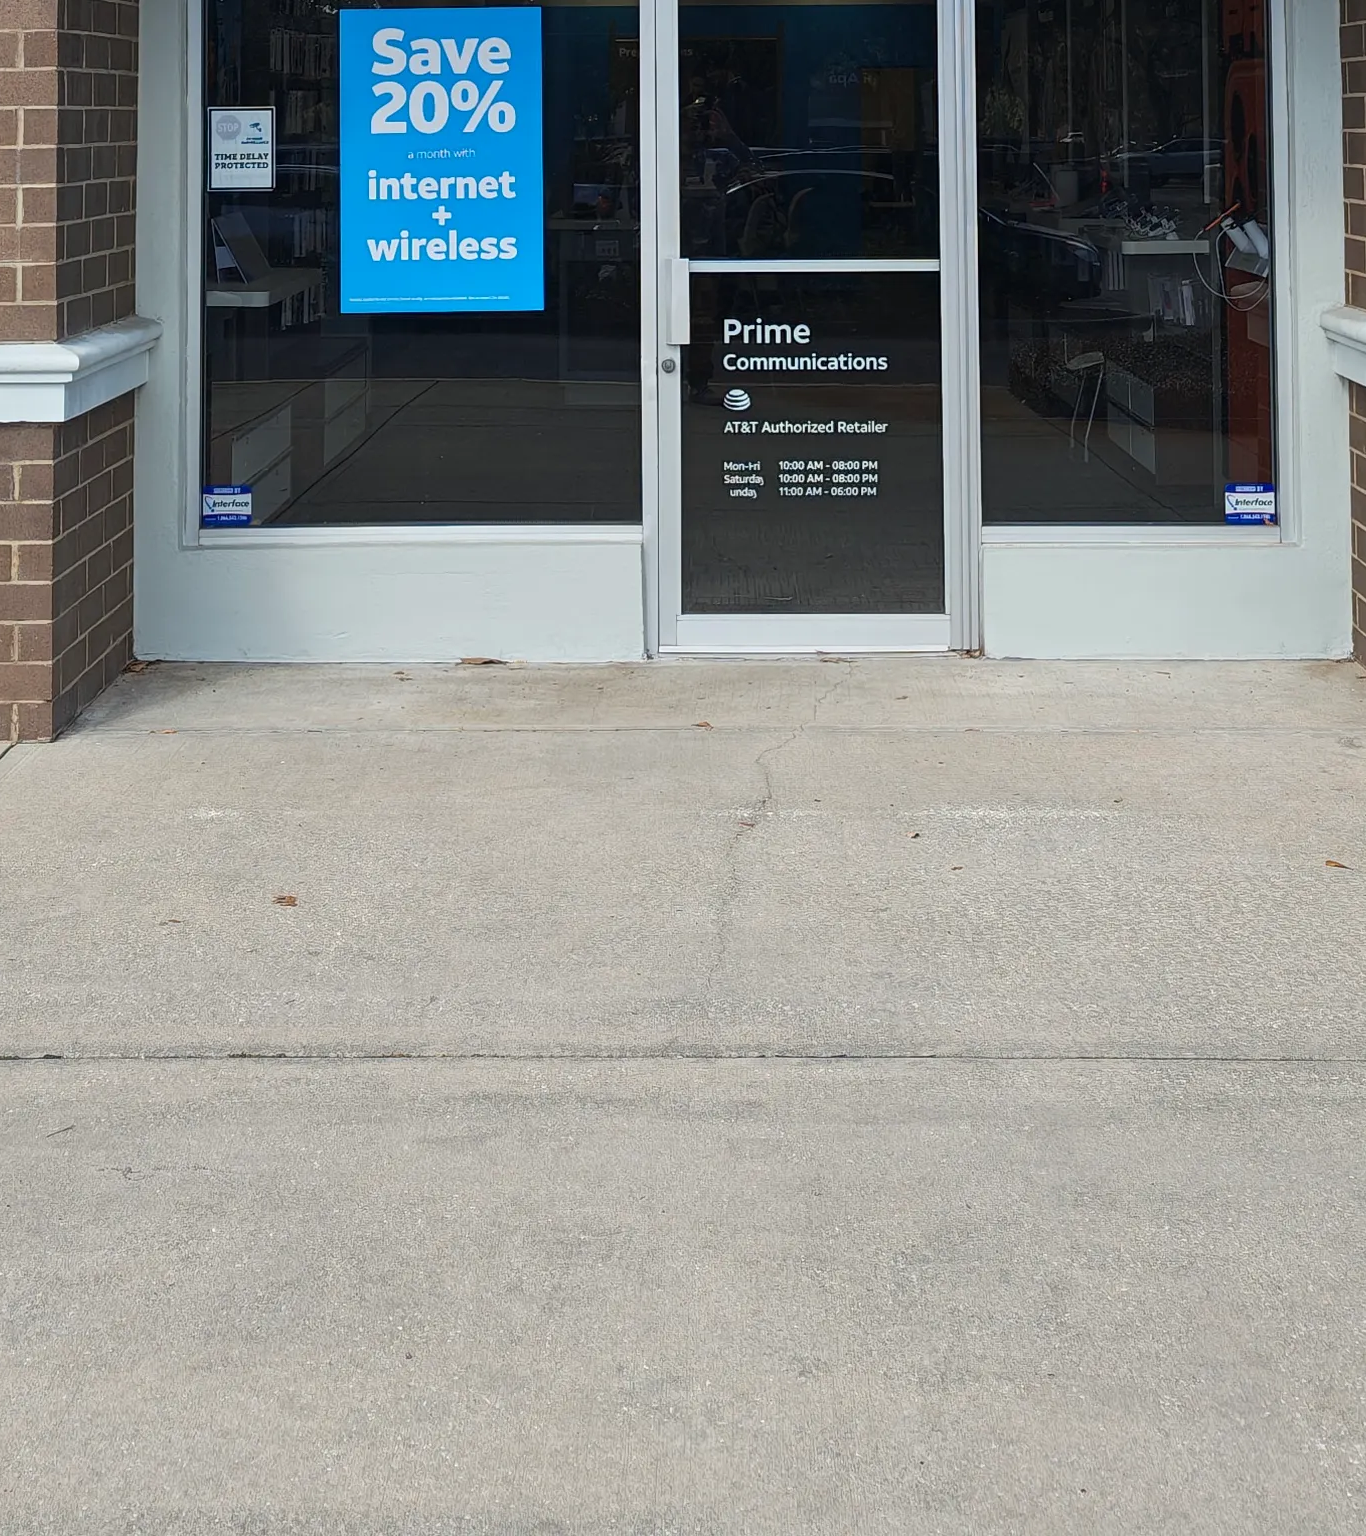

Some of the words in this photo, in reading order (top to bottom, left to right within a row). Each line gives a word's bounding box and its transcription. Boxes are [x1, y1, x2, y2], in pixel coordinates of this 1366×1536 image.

[370, 27, 512, 76] Save
[370, 80, 517, 135] 20%
[217, 123, 240, 133] STOP
[214, 153, 238, 161] TIME
[239, 152, 269, 161] DELAY
[407, 151, 414, 159] a
[416, 148, 451, 159] month
[453, 147, 476, 158] with
[214, 161, 269, 169] PROTECTED
[367, 169, 517, 200] internet
[366, 229, 518, 262] wireless
[722, 317, 811, 345] Prime
[722, 352, 889, 371] Communications
[723, 421, 758, 434] AT&T
[761, 420, 835, 434] Authorized
[837, 420, 889, 434] Retailer
[778, 460, 805, 470] 10:00
[806, 460, 824, 470] AM
[832, 460, 860, 470] 08:00
[861, 460, 878, 470] PM
[778, 473, 805, 483] 10:00
[806, 473, 824, 483] AM
[832, 473, 860, 483] 08:00
[861, 473, 878, 483] PM
[778, 486, 804, 496] 11:00
[805, 486, 823, 496] AM
[830, 486, 859, 496] 06:00
[860, 486, 877, 496] PM
[212, 498, 250, 508] Interface
[1235, 497, 1274, 506] Interface
